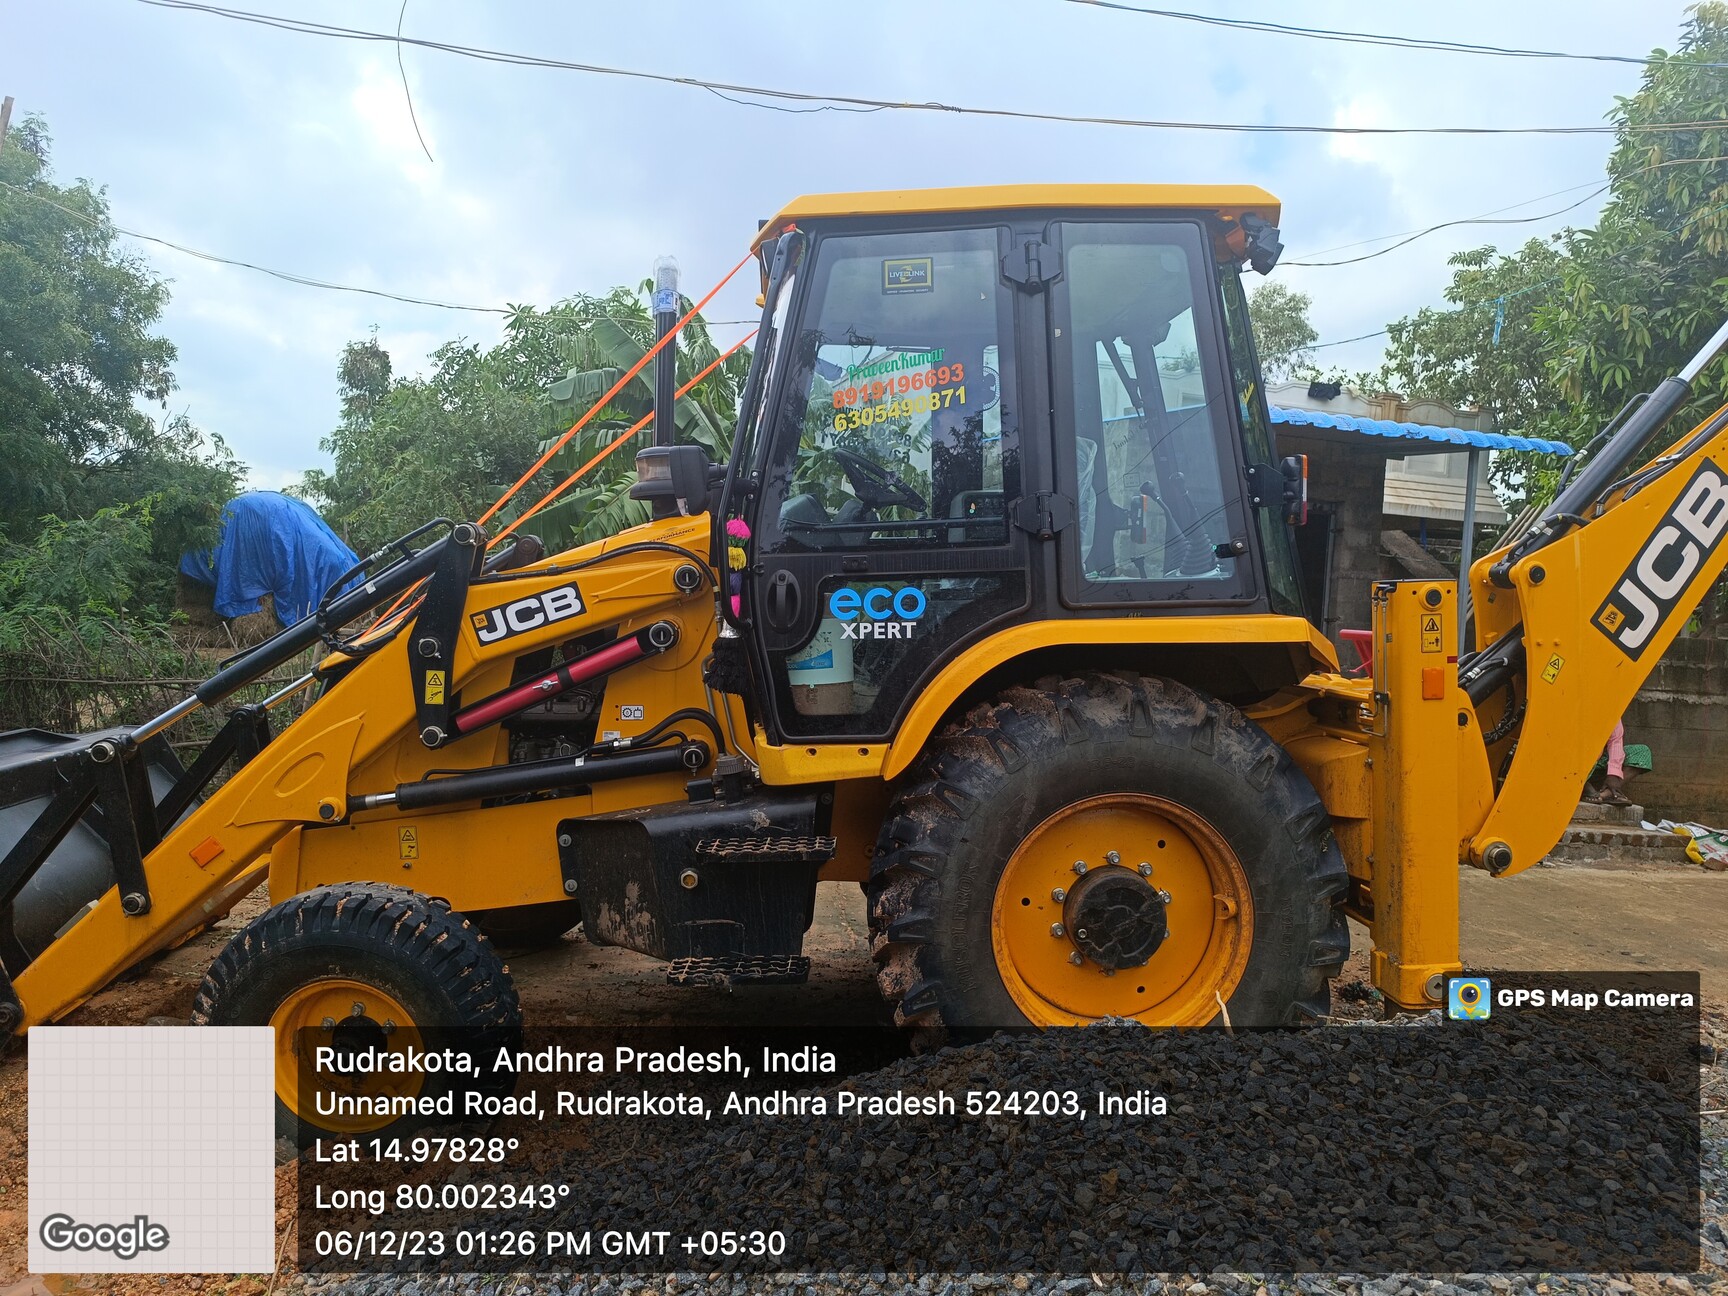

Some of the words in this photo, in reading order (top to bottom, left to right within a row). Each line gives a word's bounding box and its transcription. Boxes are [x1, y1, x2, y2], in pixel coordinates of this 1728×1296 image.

[832, 363, 966, 409] 8919196693
[834, 385, 967, 432] 6305490871
[1617, 470, 1728, 649] JCB
[478, 586, 582, 642] JCB
[829, 586, 926, 620] eco
[839, 621, 918, 640] XPERT
